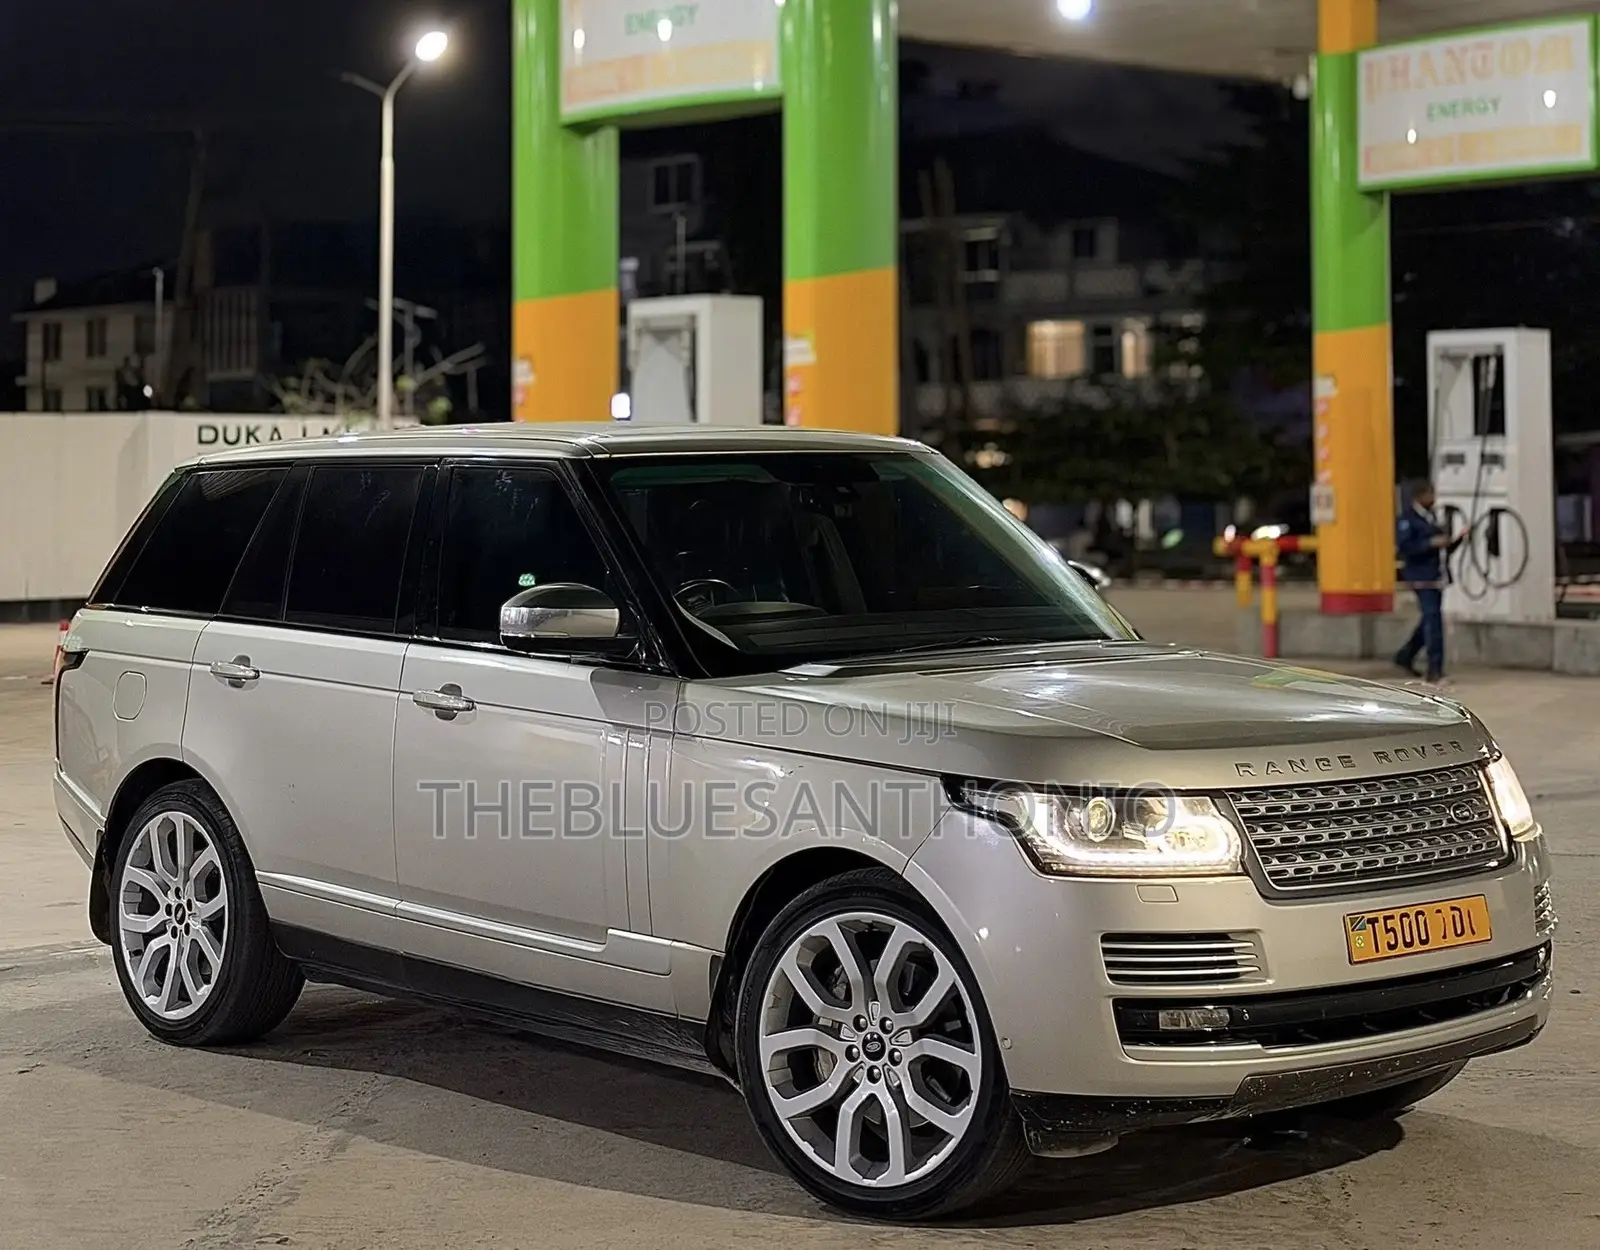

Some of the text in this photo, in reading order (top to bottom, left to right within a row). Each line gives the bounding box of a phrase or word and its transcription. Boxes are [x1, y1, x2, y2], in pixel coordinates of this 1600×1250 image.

[1426, 97, 1502, 122] ENERGY
[1233, 740, 1465, 778] RANGE ROVER
[1366, 910, 1430, 954] T500
